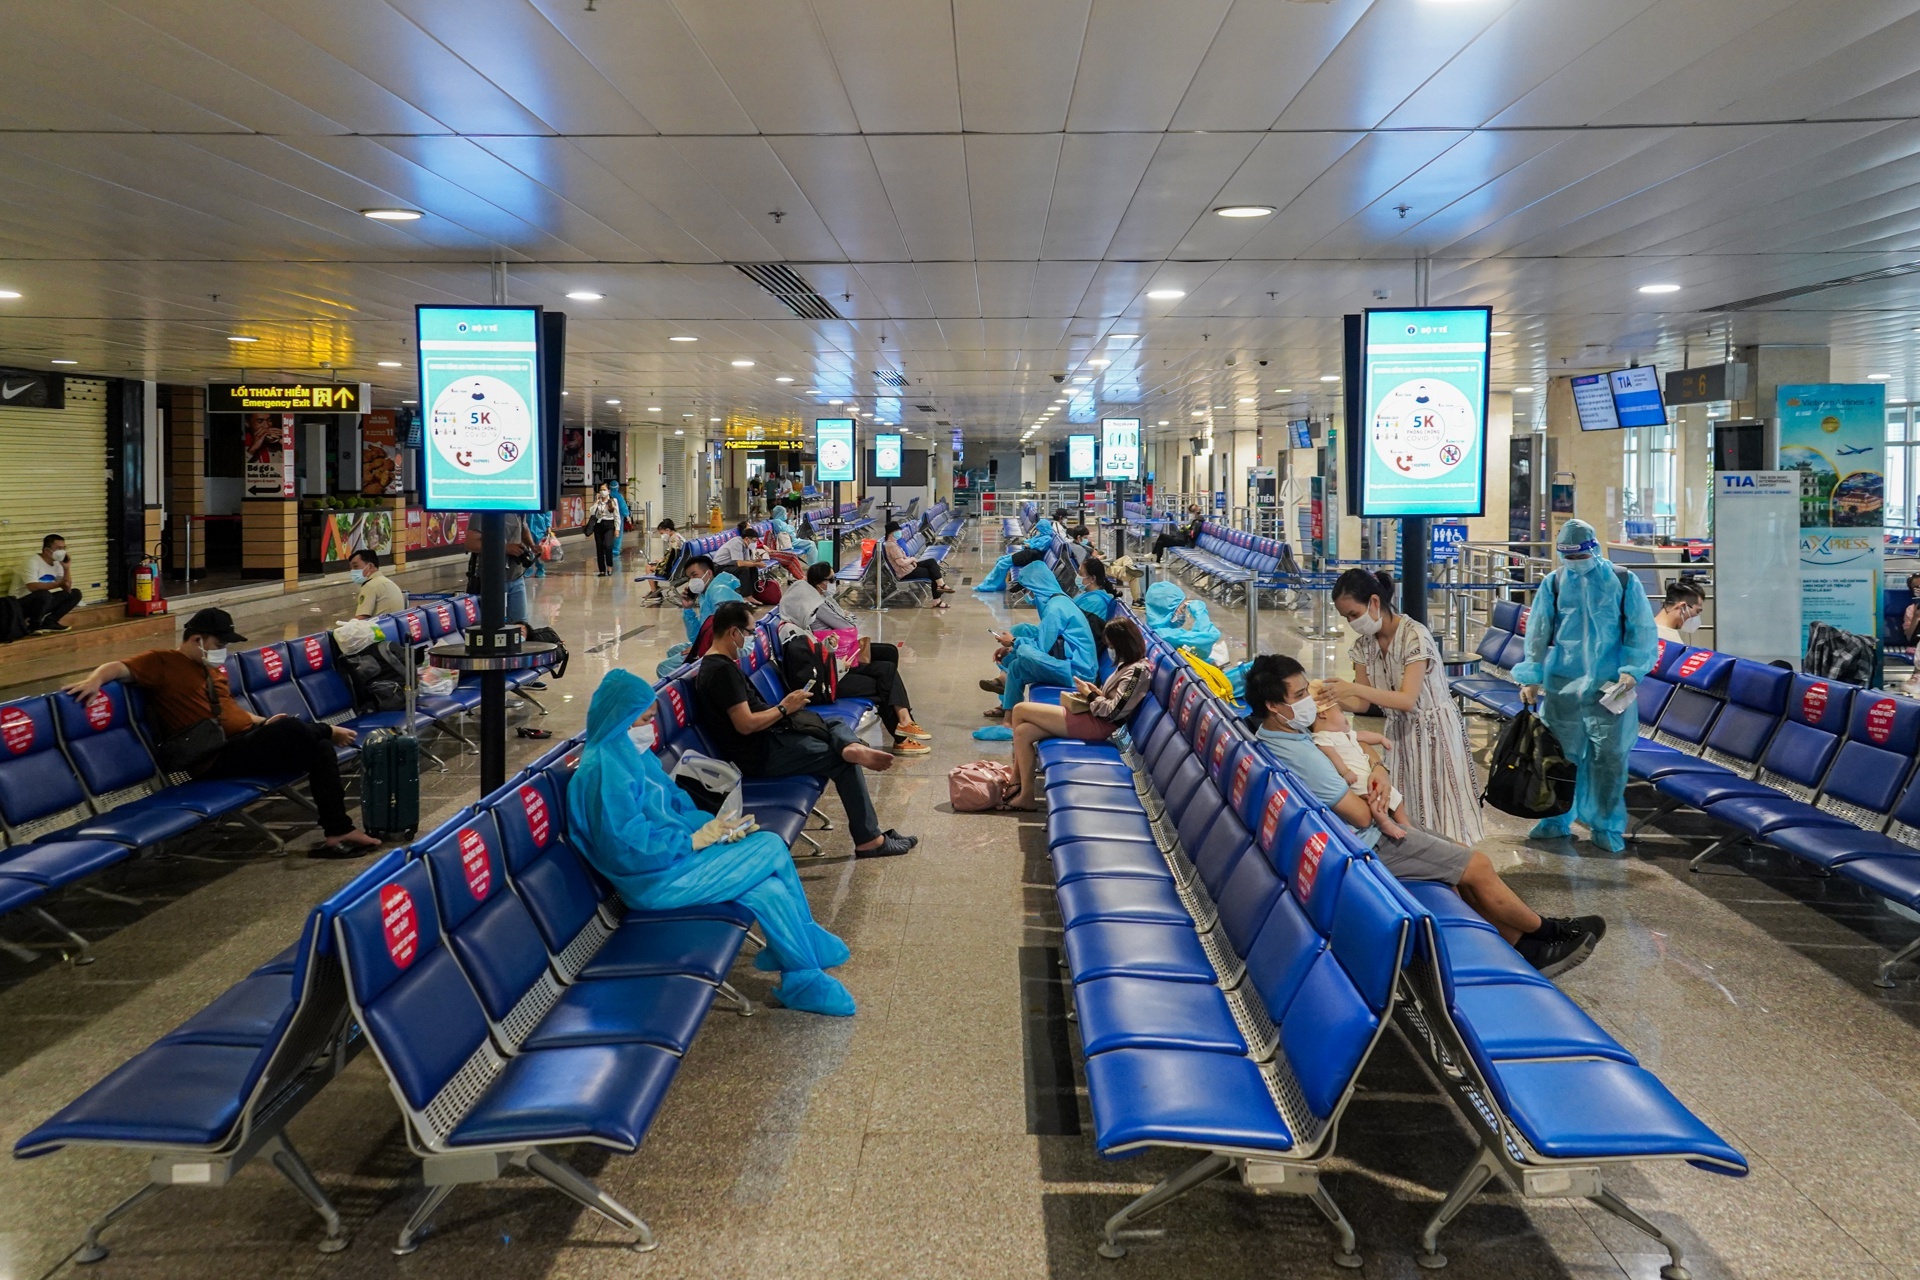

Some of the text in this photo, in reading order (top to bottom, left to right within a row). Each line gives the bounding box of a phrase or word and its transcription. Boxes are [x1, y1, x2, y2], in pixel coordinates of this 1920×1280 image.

[1617, 376, 1632, 389] TIA
[1699, 374, 1706, 396] 6
[231, 384, 310, 397] LỐI THOÁT HIỂM
[242, 399, 310, 408] Emergency Exit
[790, 441, 803, 449] 1-3
[1723, 476, 1755, 487] TIA
